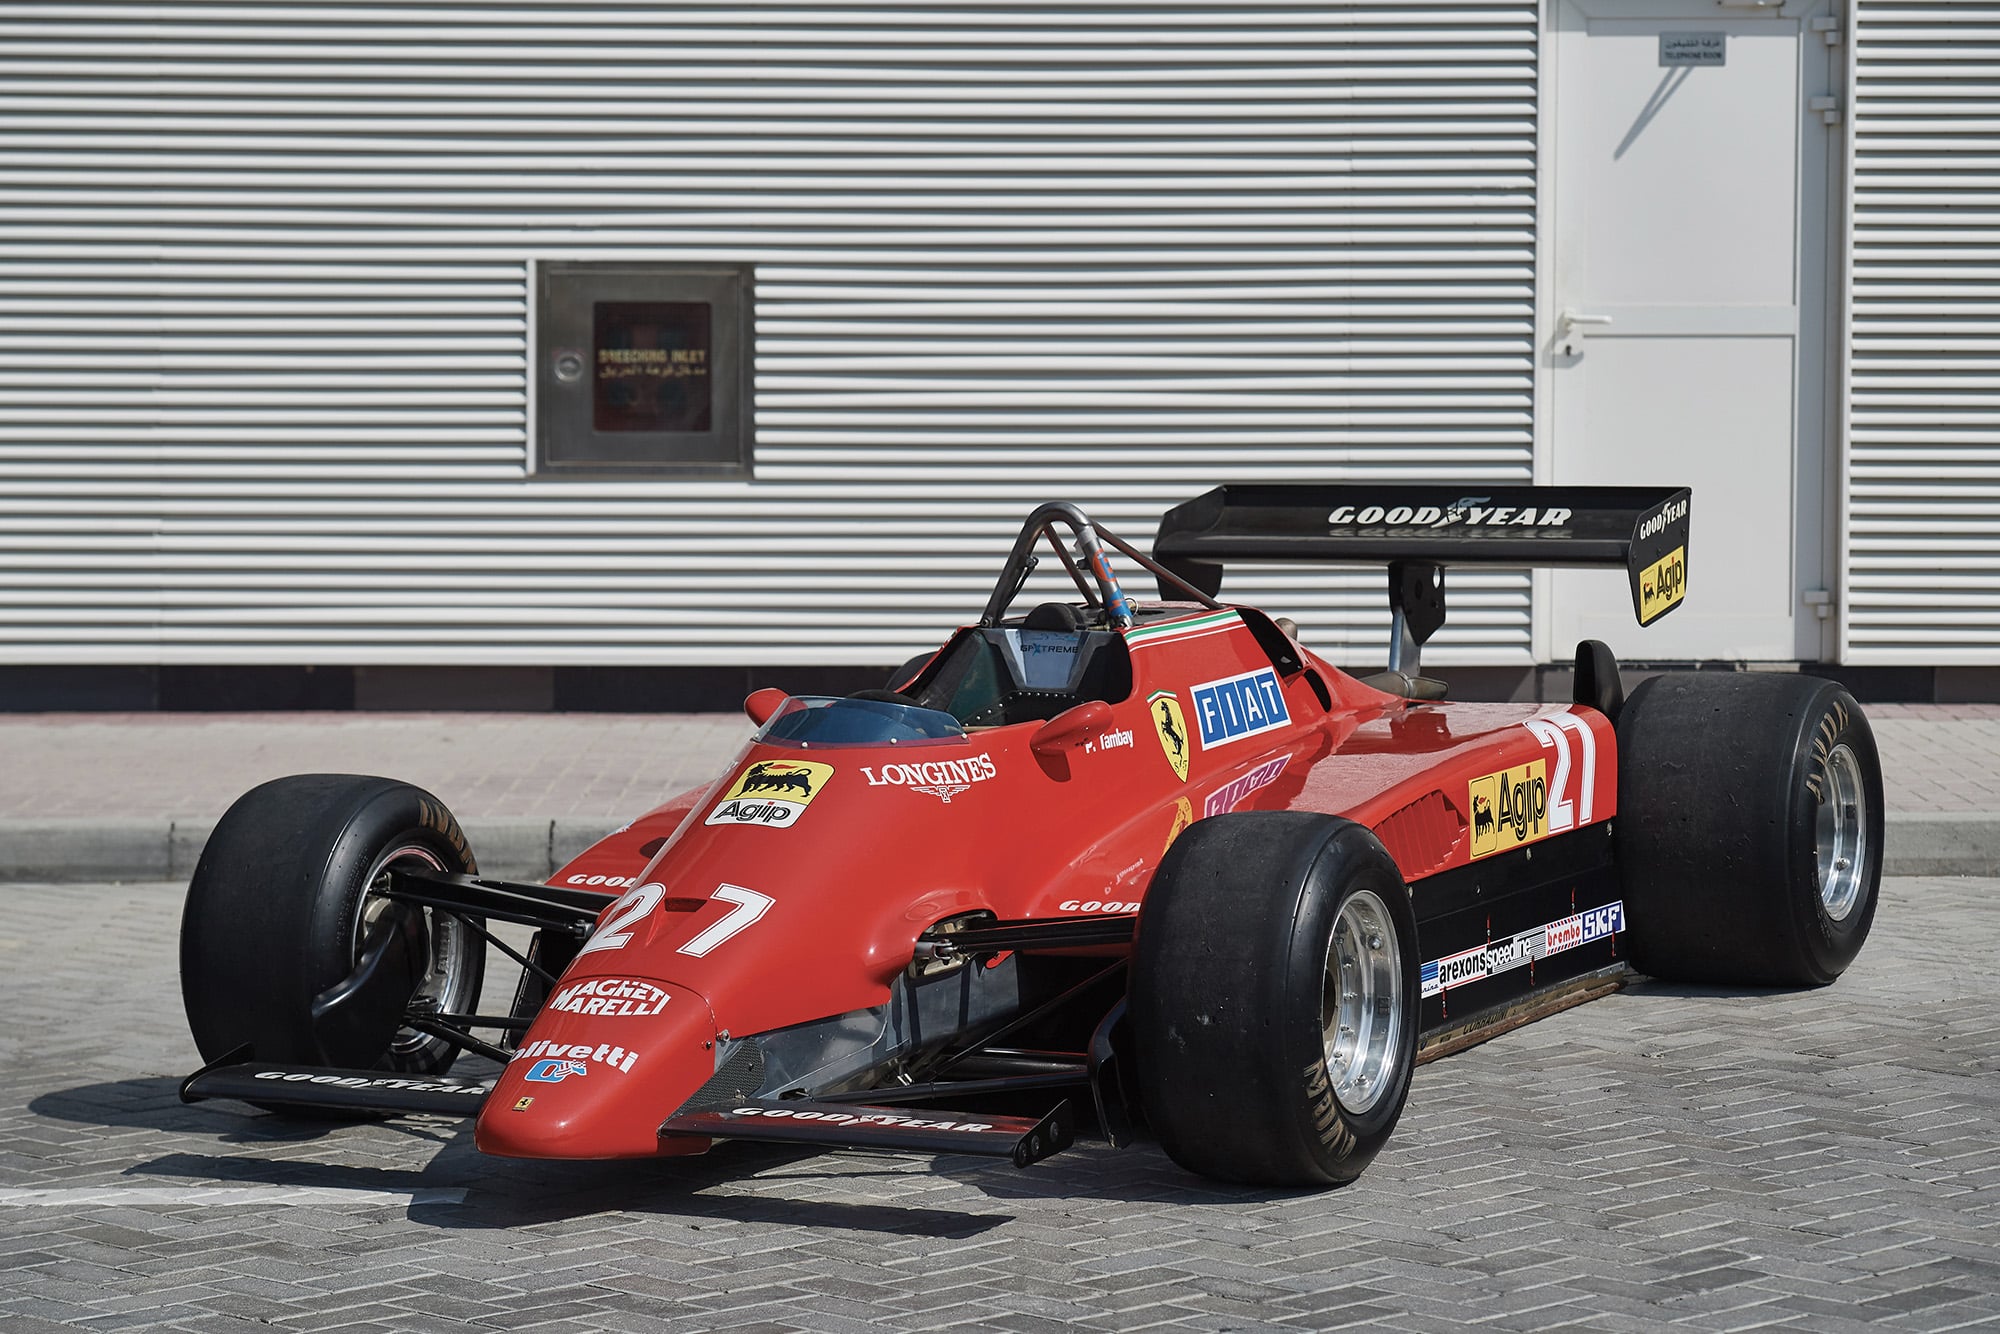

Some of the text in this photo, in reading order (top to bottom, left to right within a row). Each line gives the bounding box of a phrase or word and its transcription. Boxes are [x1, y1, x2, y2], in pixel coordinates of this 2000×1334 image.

[671, 349, 705, 363] INLET
[1656, 556, 1683, 601] Agip
[1202, 680, 1279, 734] FIAT
[1099, 728, 1134, 750] Tambay
[859, 752, 997, 786] LONGINES
[1521, 712, 1596, 835] 27
[713, 801, 791, 823] Agip
[1497, 765, 1546, 841] Agip
[1438, 906, 1620, 985] arexons speedline brembo SKF
[549, 996, 672, 1016] MARELLI
